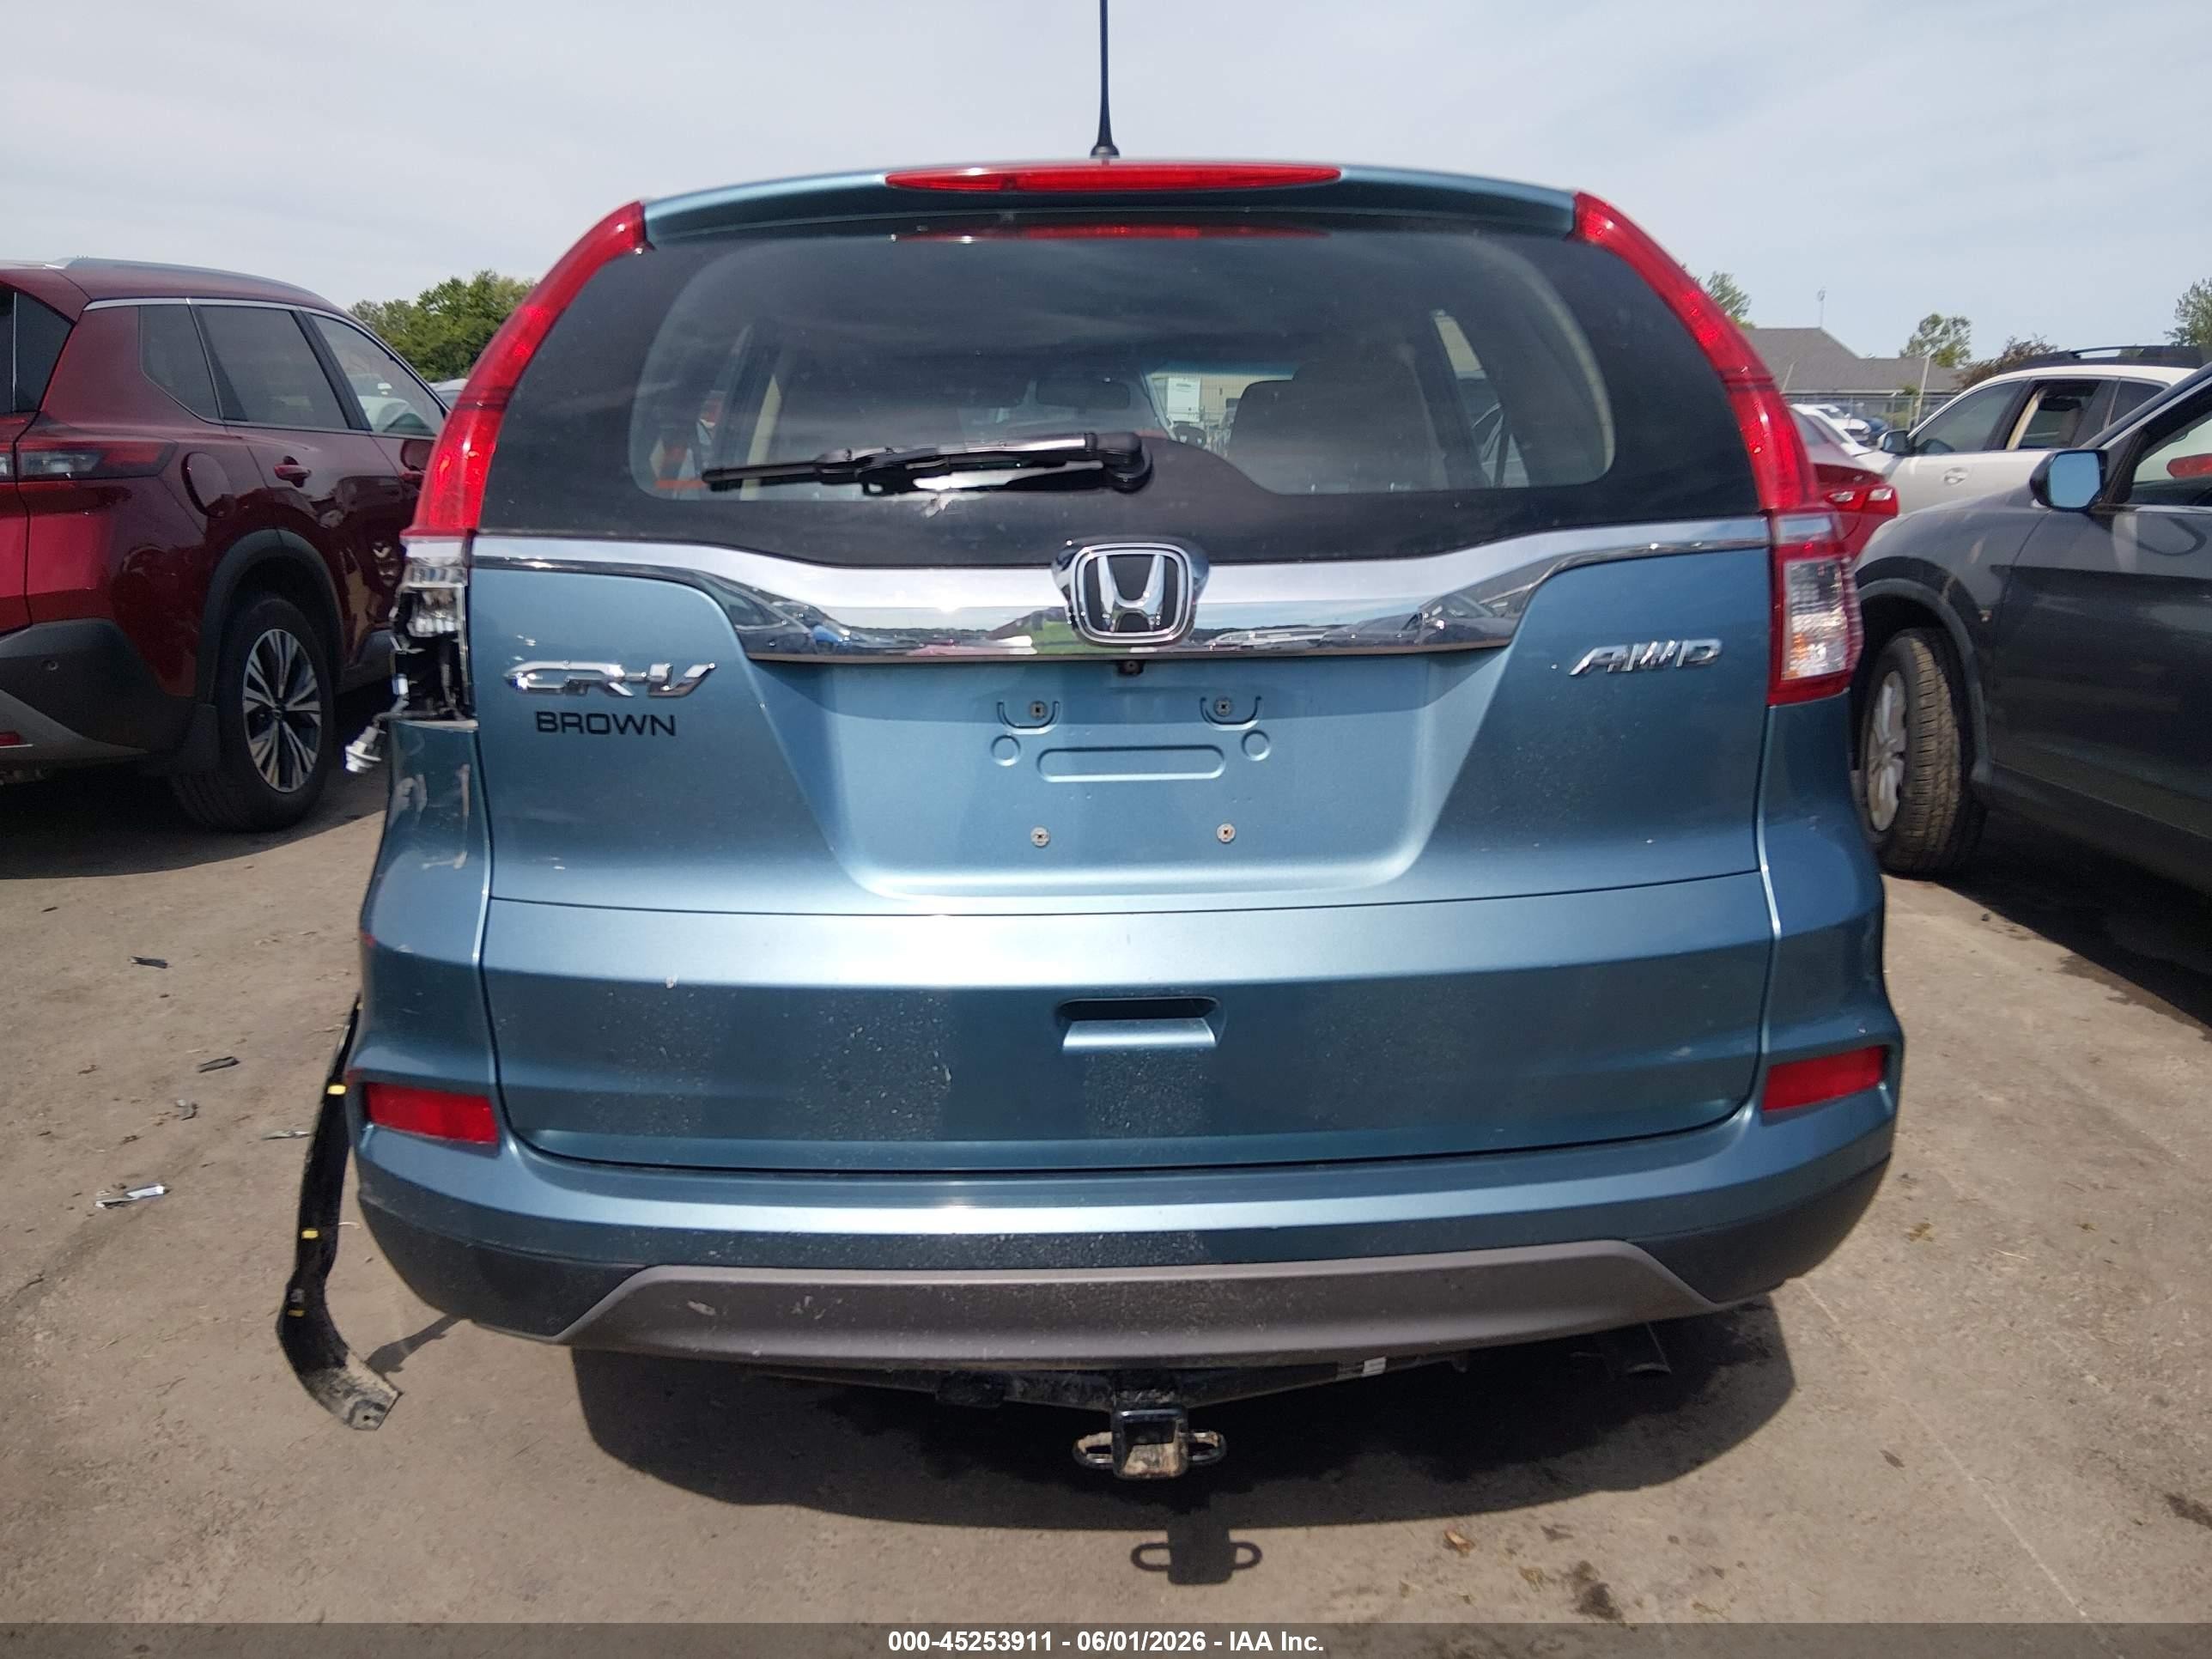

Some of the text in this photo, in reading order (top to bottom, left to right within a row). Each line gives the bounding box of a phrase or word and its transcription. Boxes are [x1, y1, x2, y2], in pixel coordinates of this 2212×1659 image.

[1568, 639, 1723, 677] AWD
[504, 660, 717, 698] CR-V
[535, 711, 677, 737] BROWN
